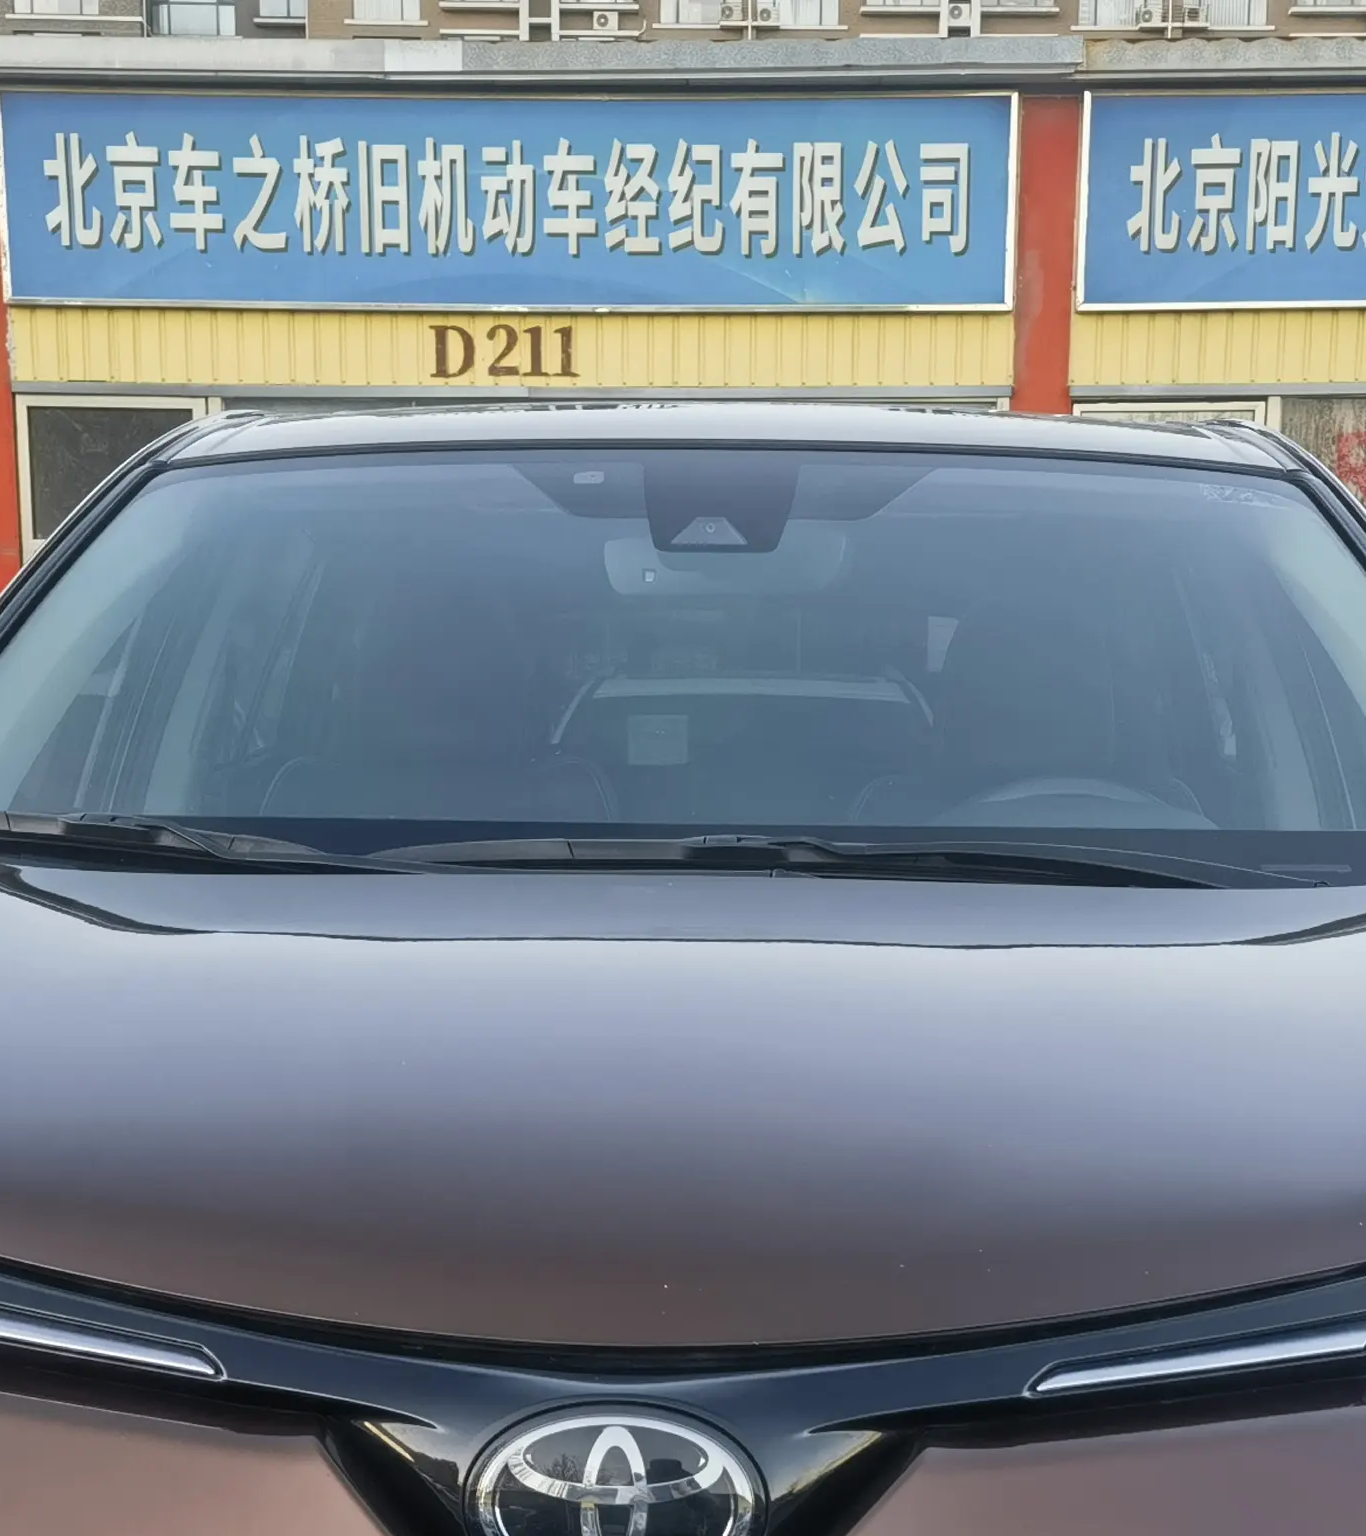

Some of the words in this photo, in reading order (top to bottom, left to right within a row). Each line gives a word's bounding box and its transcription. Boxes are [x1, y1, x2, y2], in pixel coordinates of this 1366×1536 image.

[44, 132, 970, 255] 北京车之桥旧机动车经纪有限公司
[430, 323, 580, 380] D211
